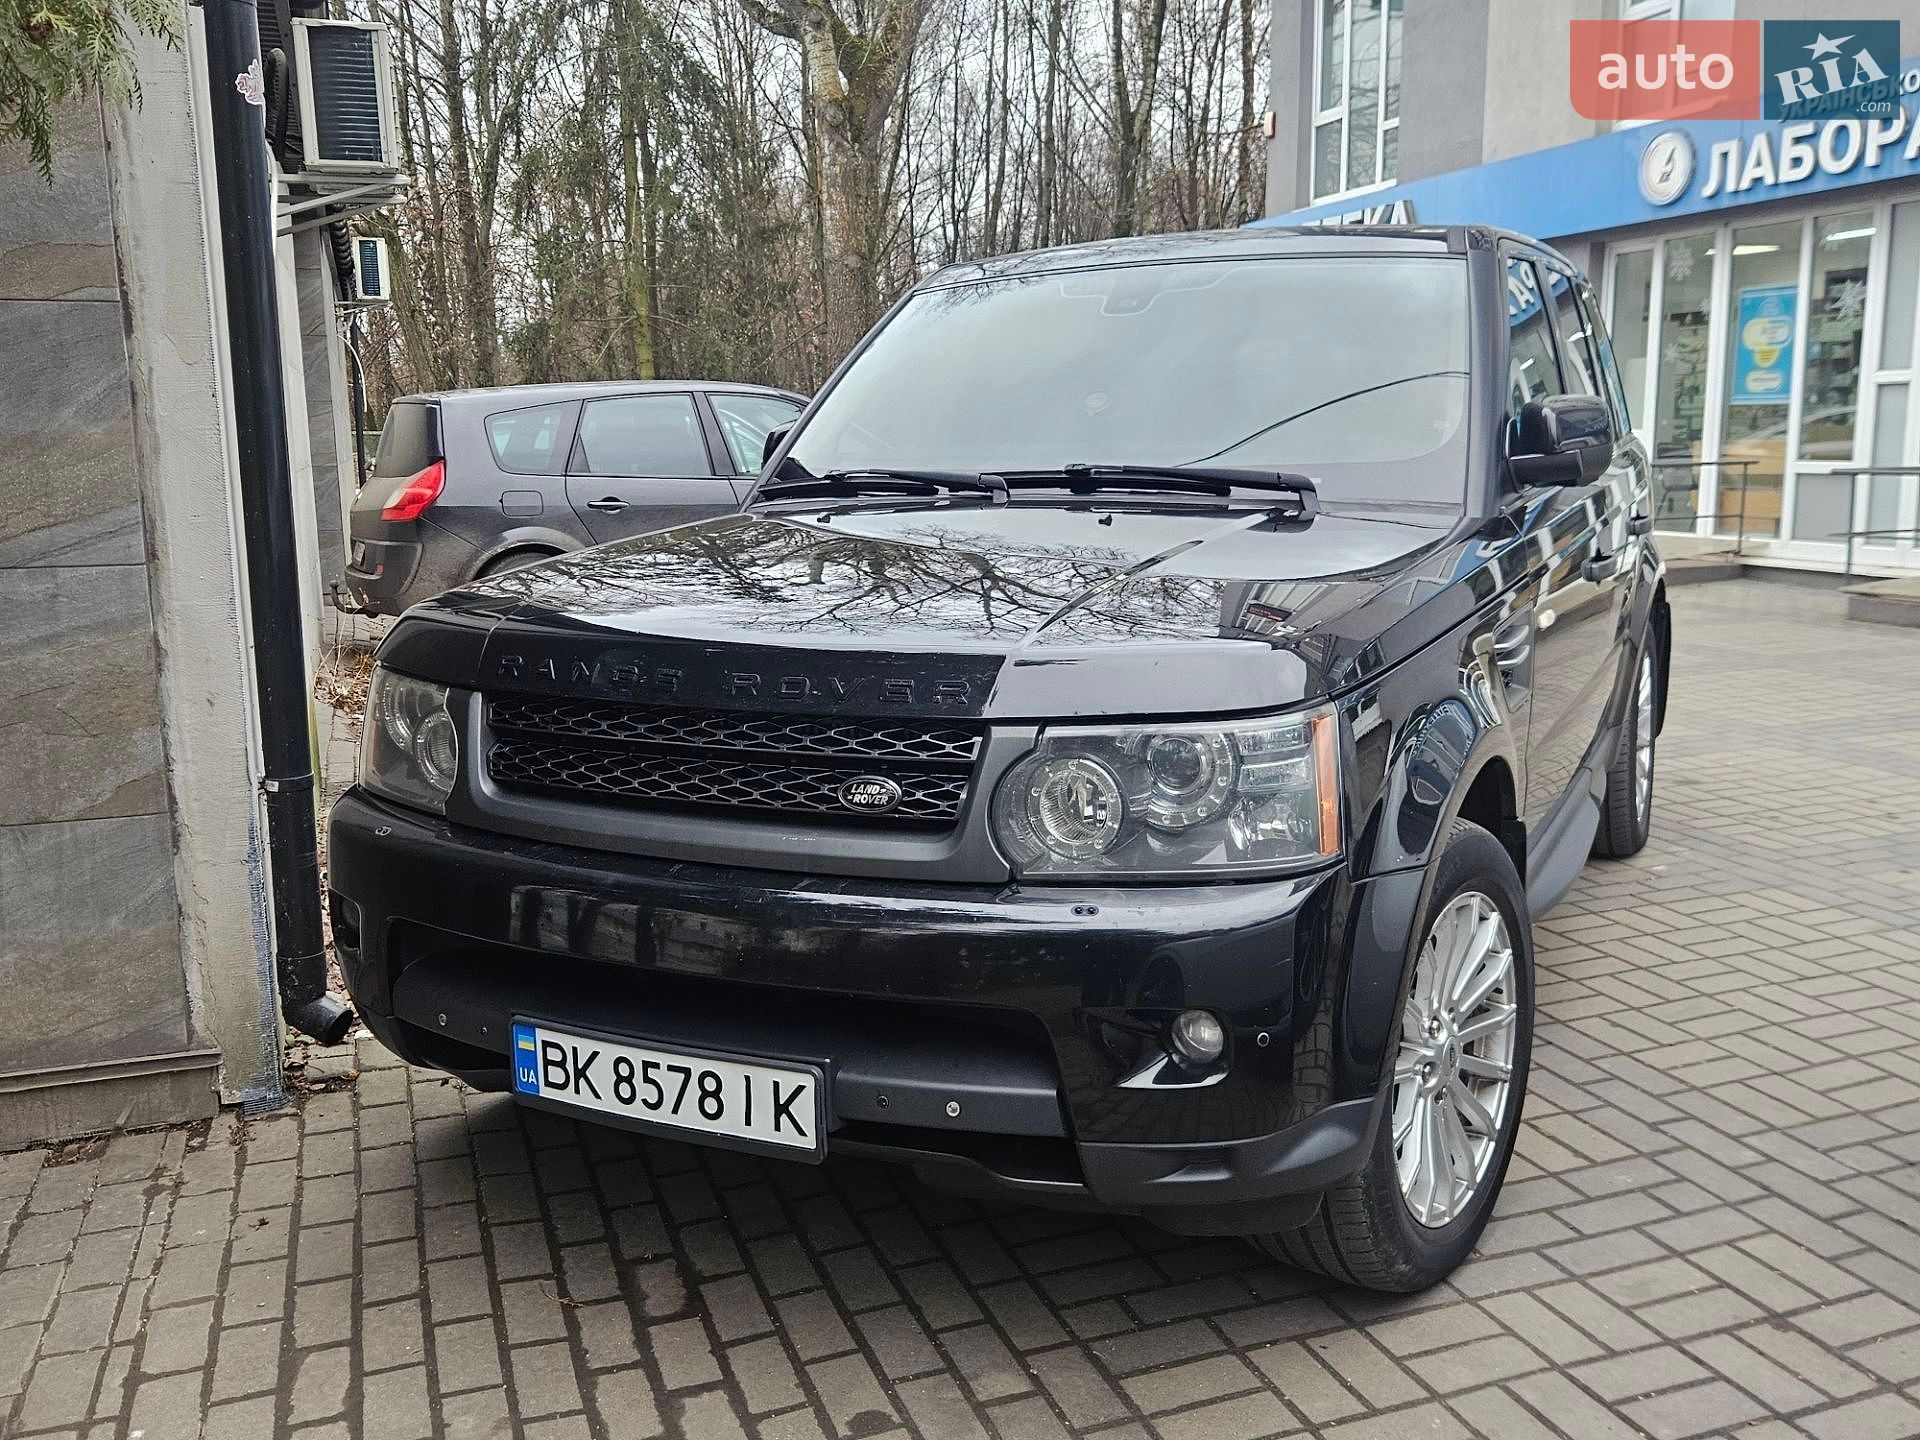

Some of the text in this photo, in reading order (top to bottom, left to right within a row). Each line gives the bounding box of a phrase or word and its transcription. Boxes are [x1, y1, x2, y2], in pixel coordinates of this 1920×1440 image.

[734, 671, 970, 705] ROVER
[850, 783, 881, 795] LAND
[852, 793, 889, 805] ROVER
[519, 1067, 537, 1085] UA
[613, 1055, 724, 1121] 8578
